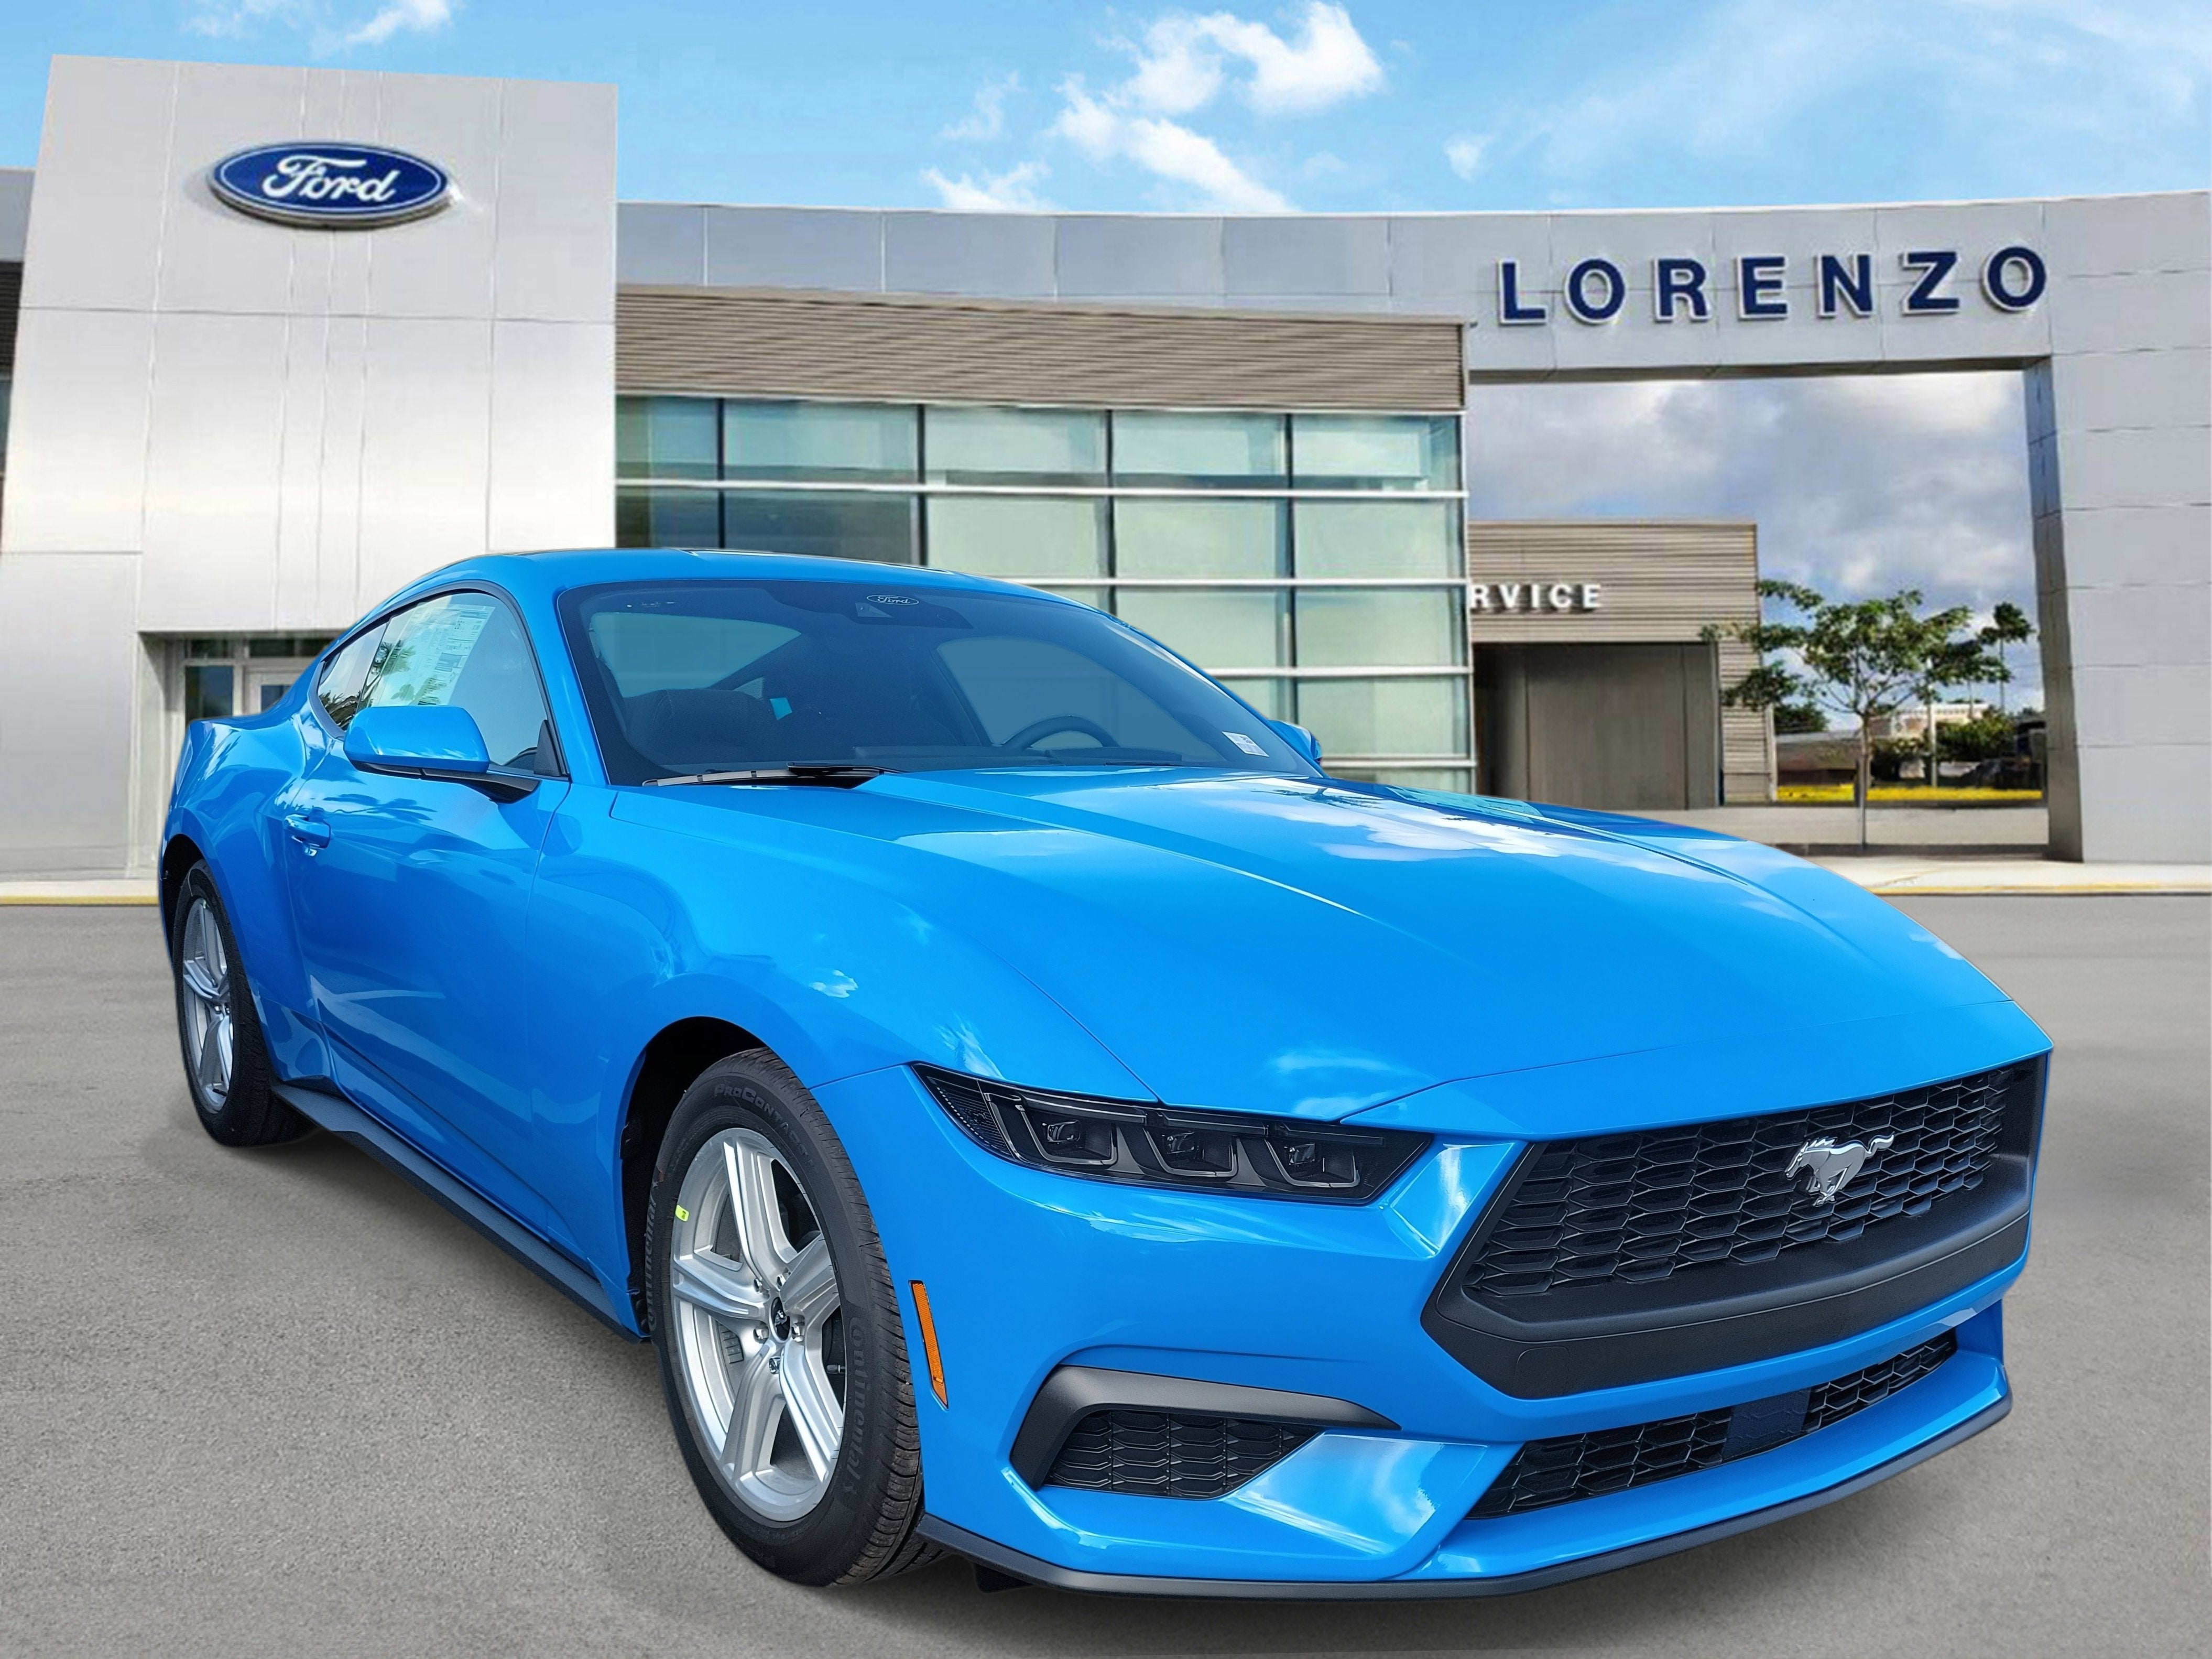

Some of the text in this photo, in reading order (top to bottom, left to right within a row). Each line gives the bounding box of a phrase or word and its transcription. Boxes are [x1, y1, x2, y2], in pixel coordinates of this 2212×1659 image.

[263, 154, 400, 201] Ford
[1497, 246, 2047, 326] LORENZO
[877, 595, 910, 604] Ford
[846, 1317, 868, 1480] Continental
